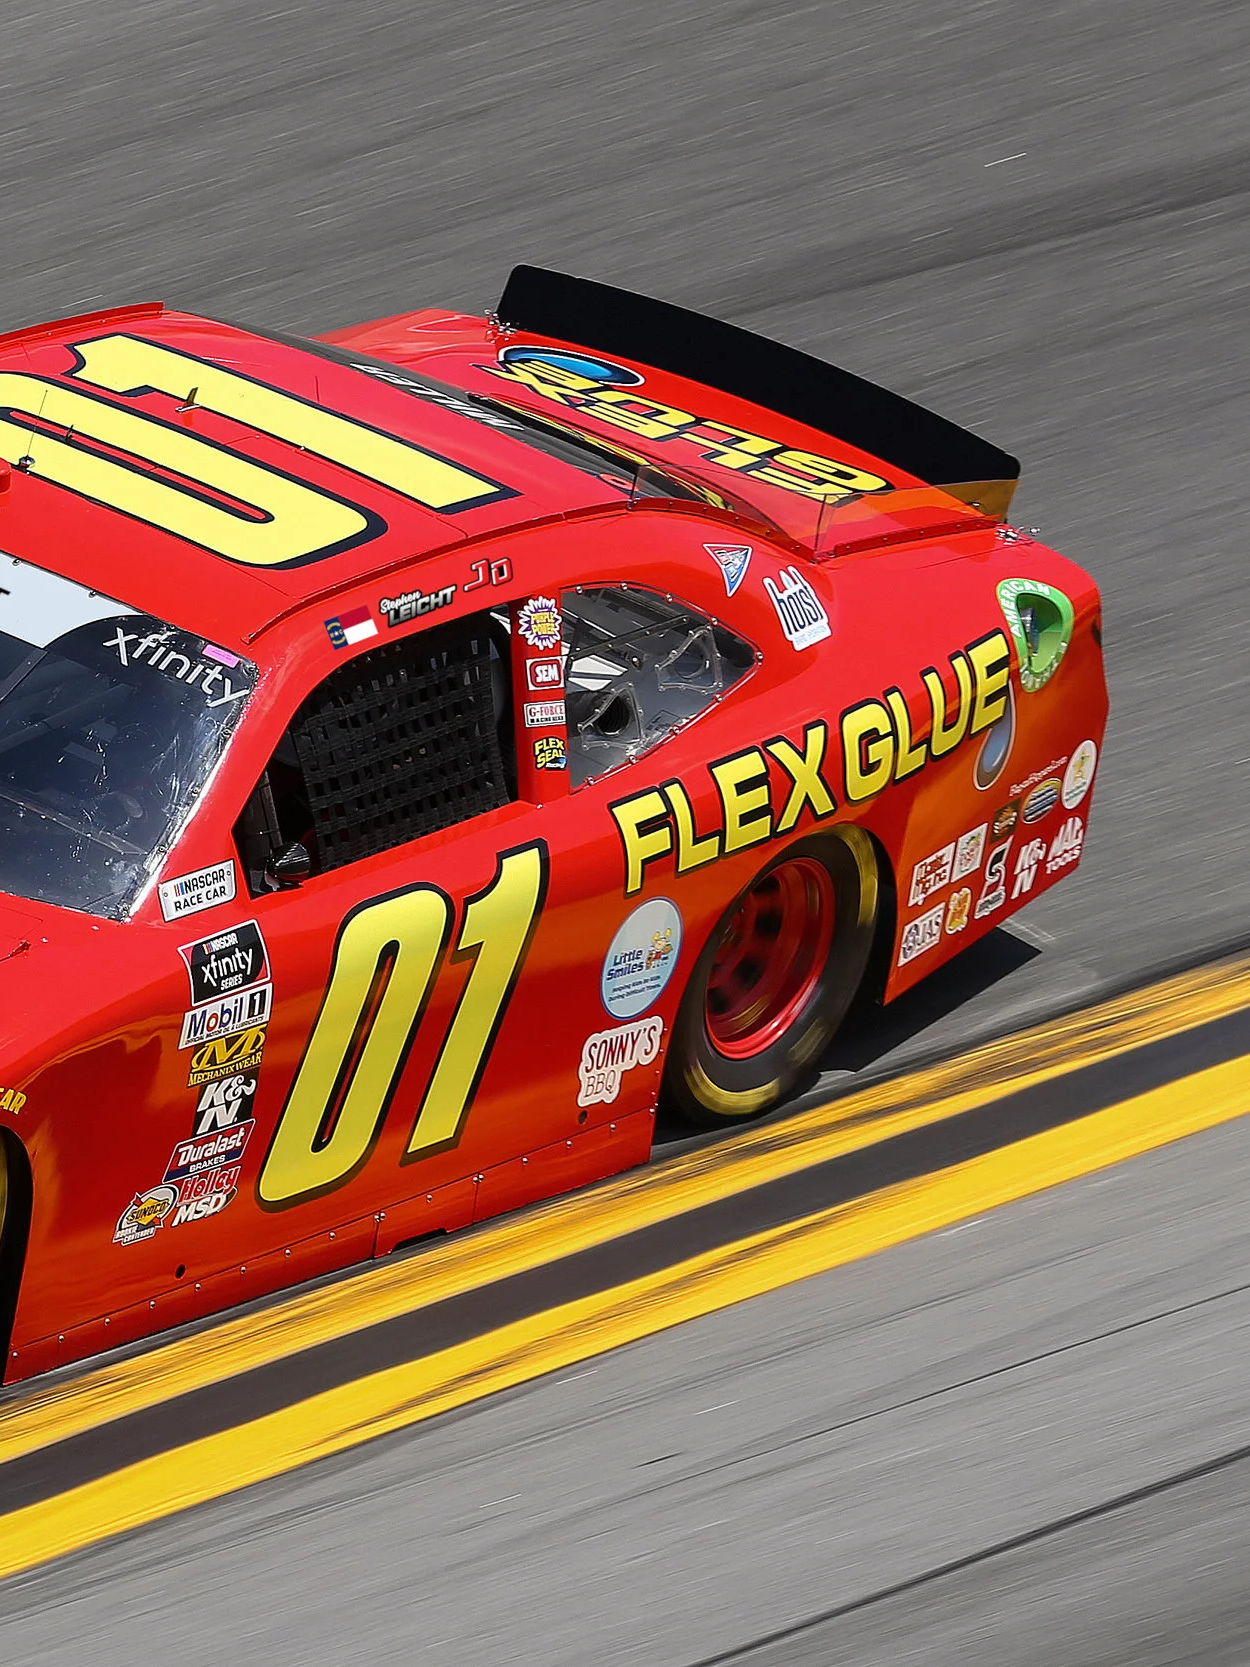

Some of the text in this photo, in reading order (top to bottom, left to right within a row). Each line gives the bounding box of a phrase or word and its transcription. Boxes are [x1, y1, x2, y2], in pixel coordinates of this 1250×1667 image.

[482, 364, 853, 504] FLEX
[506, 360, 888, 492] GLUE
[380, 590, 421, 613] Stephen
[388, 585, 457, 626] LEICHT
[1000, 580, 1051, 638] AMERICAN
[102, 626, 251, 708] xfinity
[535, 664, 559, 683] SEM
[529, 705, 563, 717] G-FORCE
[534, 737, 565, 756] FLEX
[537, 749, 566, 768] SEAL
[611, 632, 1010, 894] FLEX GLUE
[184, 869, 226, 895] NASCAR
[174, 885, 227, 912] RACE CAR
[212, 932, 239, 950] NASCAR
[201, 948, 253, 987] xfinity
[606, 961, 644, 980] Smiles
[613, 949, 643, 966] Little
[220, 973, 243, 990] SERIES
[187, 997, 244, 1039] Mobil
[256, 842, 545, 1206] 01
[585, 1025, 657, 1074] SONNY'S
[187, 1051, 262, 1087] MECHANIX WEAR
[584, 1069, 616, 1098] BBQ
[177, 1127, 245, 1167] Duralast
[188, 1154, 226, 1173] BRAKES
[177, 1166, 241, 1205] Holley
[131, 1201, 168, 1220] SUNOCO
[171, 1193, 227, 1227] MSD
